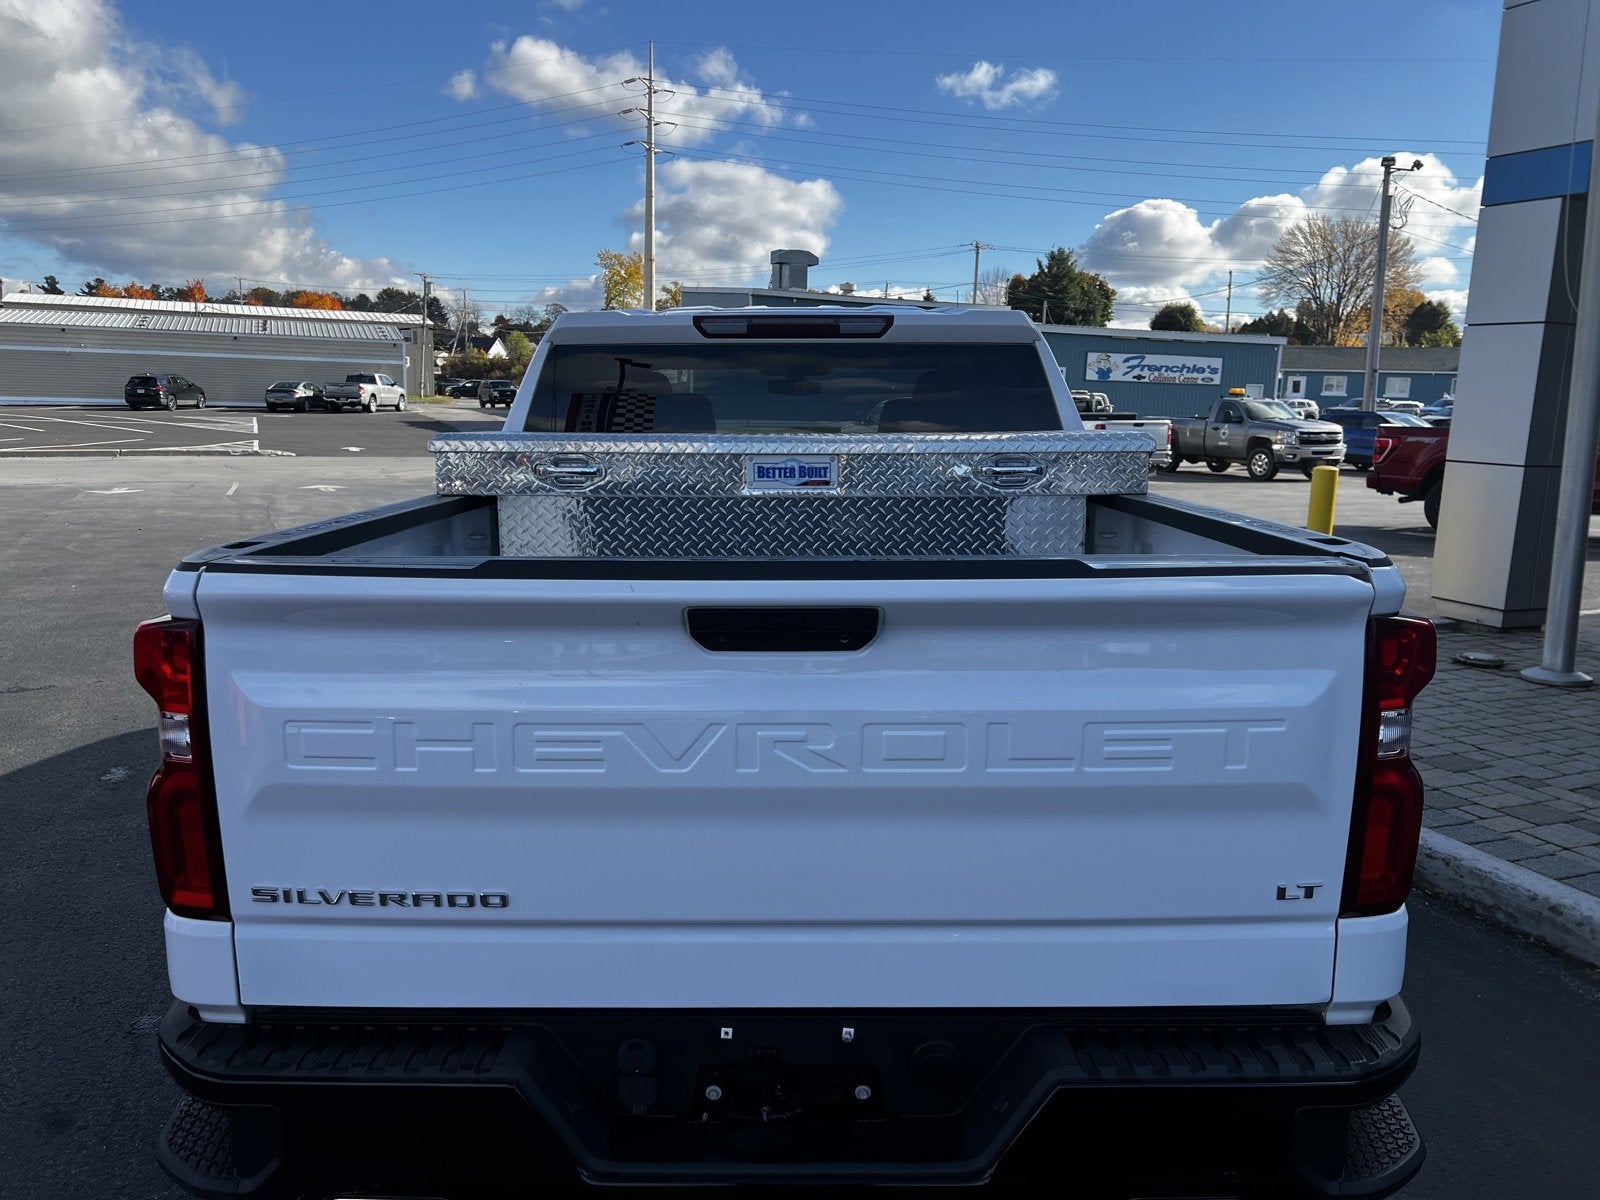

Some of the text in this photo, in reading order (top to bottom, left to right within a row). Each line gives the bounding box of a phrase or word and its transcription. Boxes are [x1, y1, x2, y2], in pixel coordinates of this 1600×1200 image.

[1122, 355, 1219, 376] Frenchie's
[1148, 373, 1176, 384] Collision
[1178, 374, 1199, 384] Center
[757, 465, 829, 479] BETTER BUILT
[284, 719, 1287, 774] CHEVROLET
[251, 886, 510, 908] SILVERADO
[1276, 883, 1323, 900] LT
